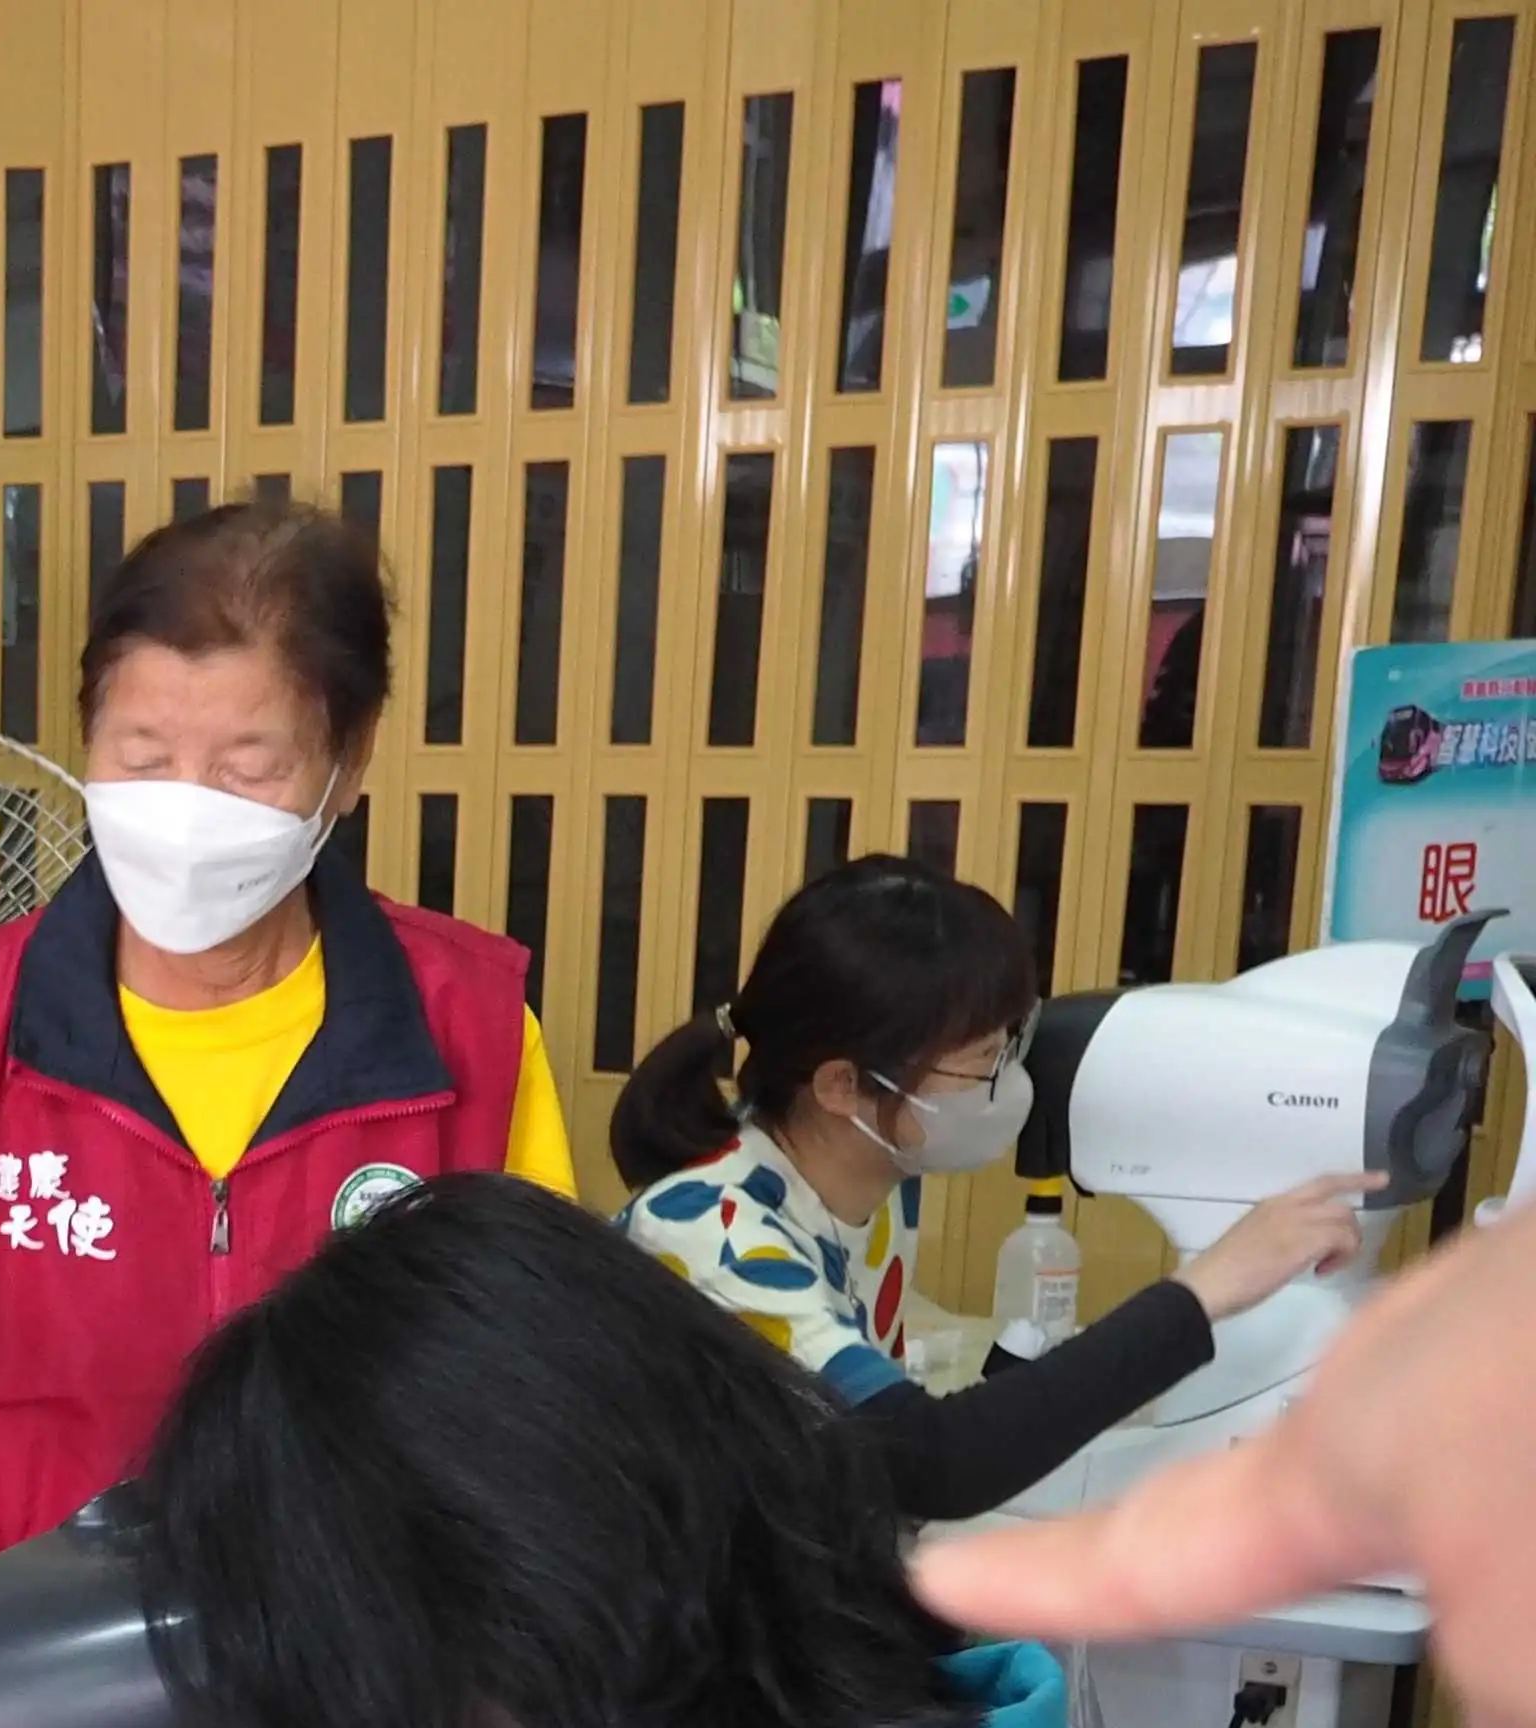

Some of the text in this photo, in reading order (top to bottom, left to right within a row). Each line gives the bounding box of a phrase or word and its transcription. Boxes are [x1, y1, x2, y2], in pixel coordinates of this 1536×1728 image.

[1418, 841, 1478, 925] 眼
[1266, 1090, 1339, 1109] Canon
[0, 1194, 117, 1261] 天使
